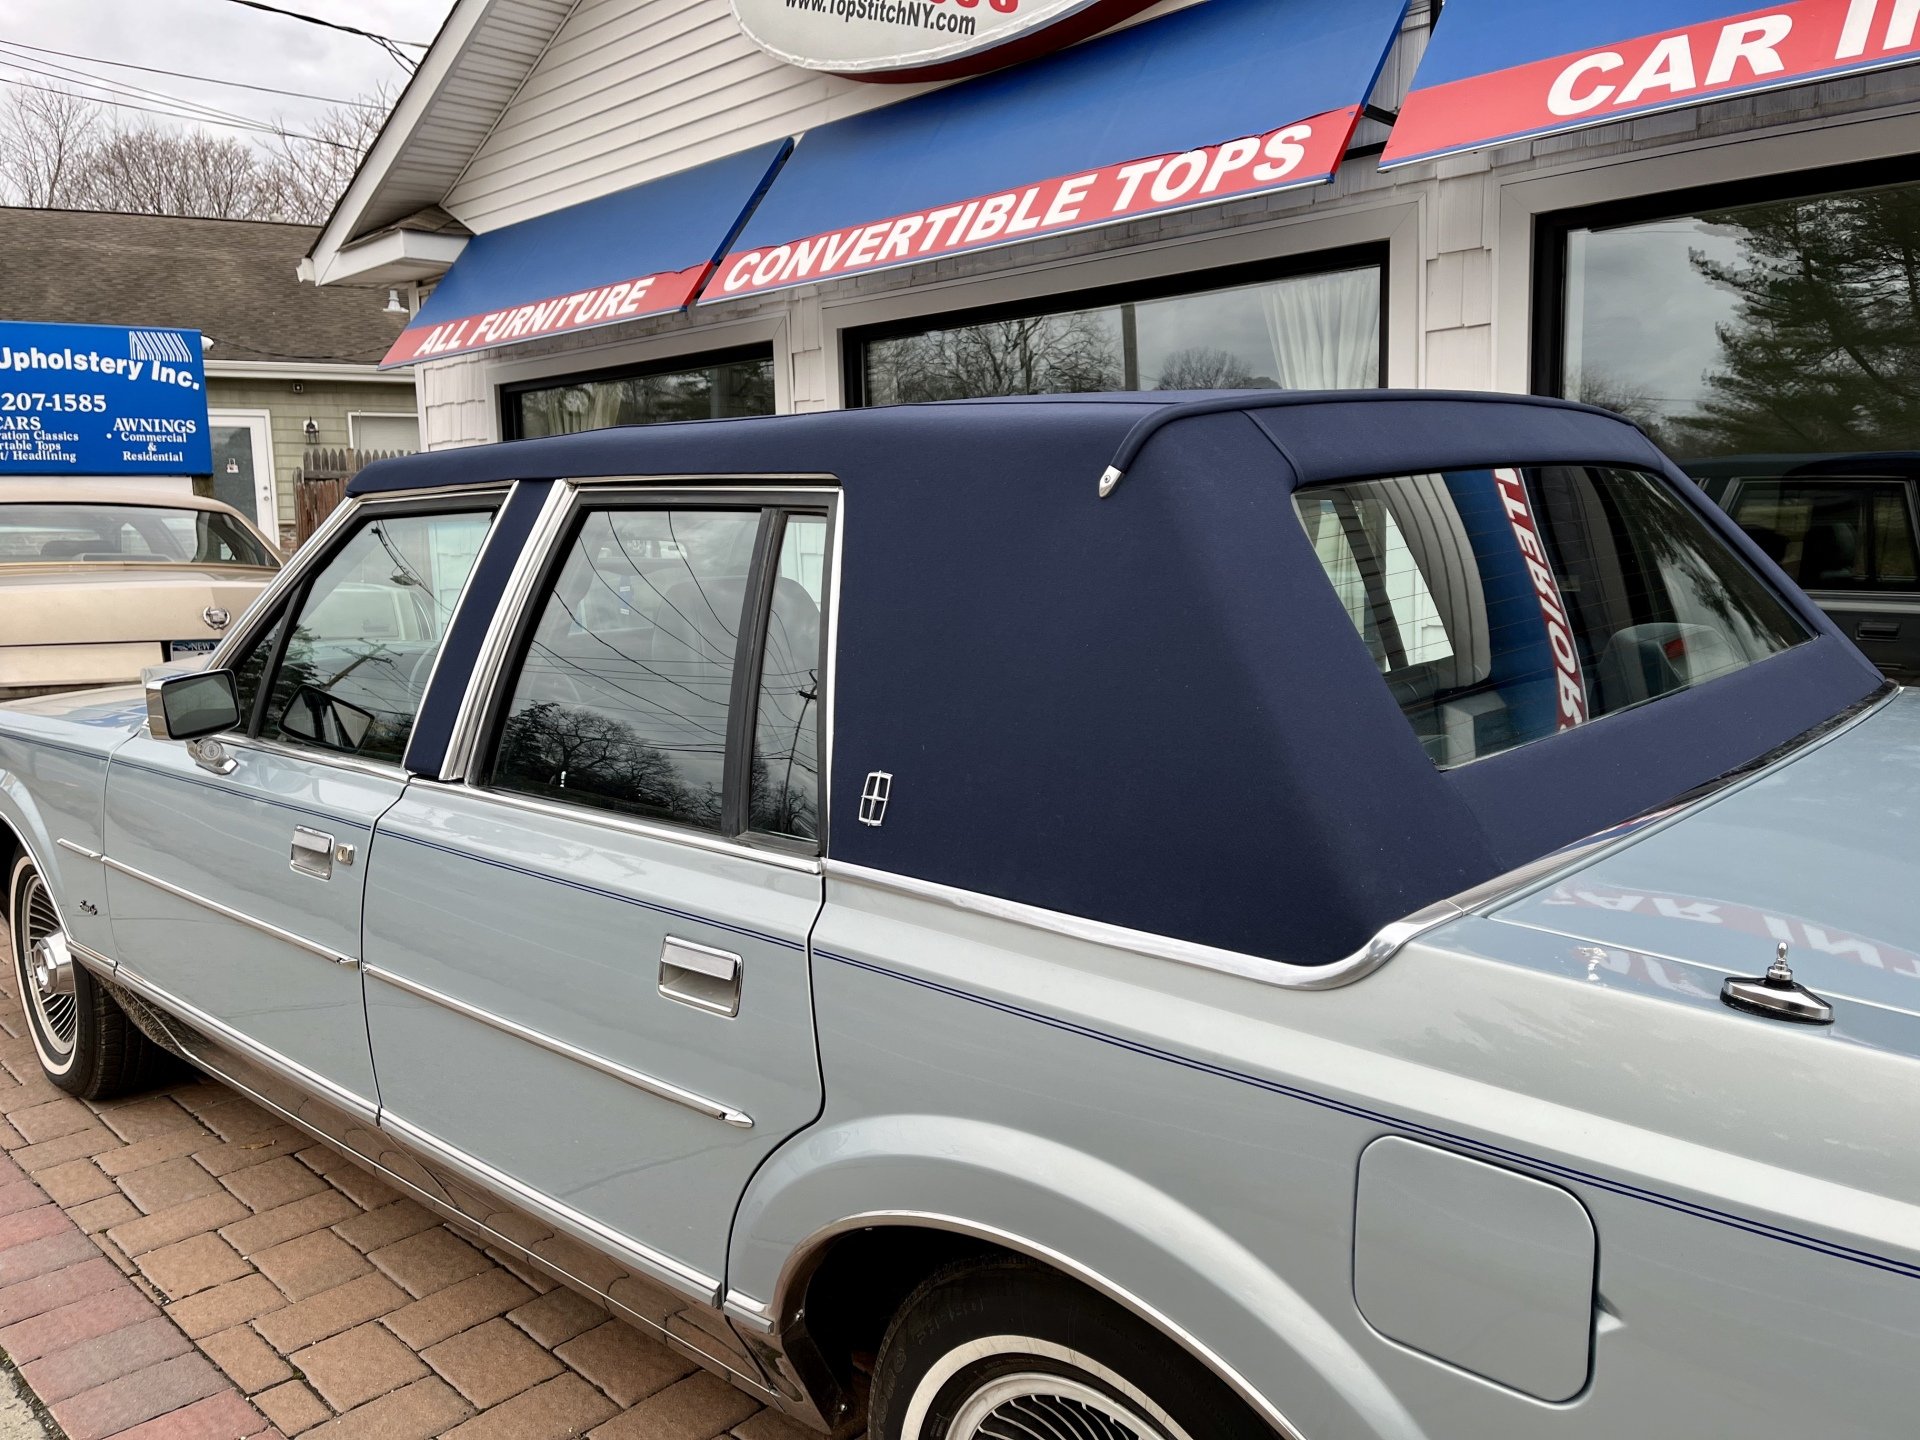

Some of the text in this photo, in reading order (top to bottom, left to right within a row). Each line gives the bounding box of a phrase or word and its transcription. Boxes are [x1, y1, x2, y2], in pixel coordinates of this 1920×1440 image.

[1547, 14, 1793, 116] CAR
[724, 124, 1311, 291] CONVERTIBLE TOPS
[413, 277, 655, 357] ALL FURNITURE
[151, 360, 200, 391] Inc.
[1, 392, 107, 412] 207-1585
[113, 417, 197, 434] AWNINGS
[33, 429, 79, 441] Classics
[121, 431, 187, 443] Commercial
[35, 440, 61, 453] Tops
[147, 442, 157, 452] &
[13, 450, 77, 464] Headlining
[123, 451, 183, 462] Residential
